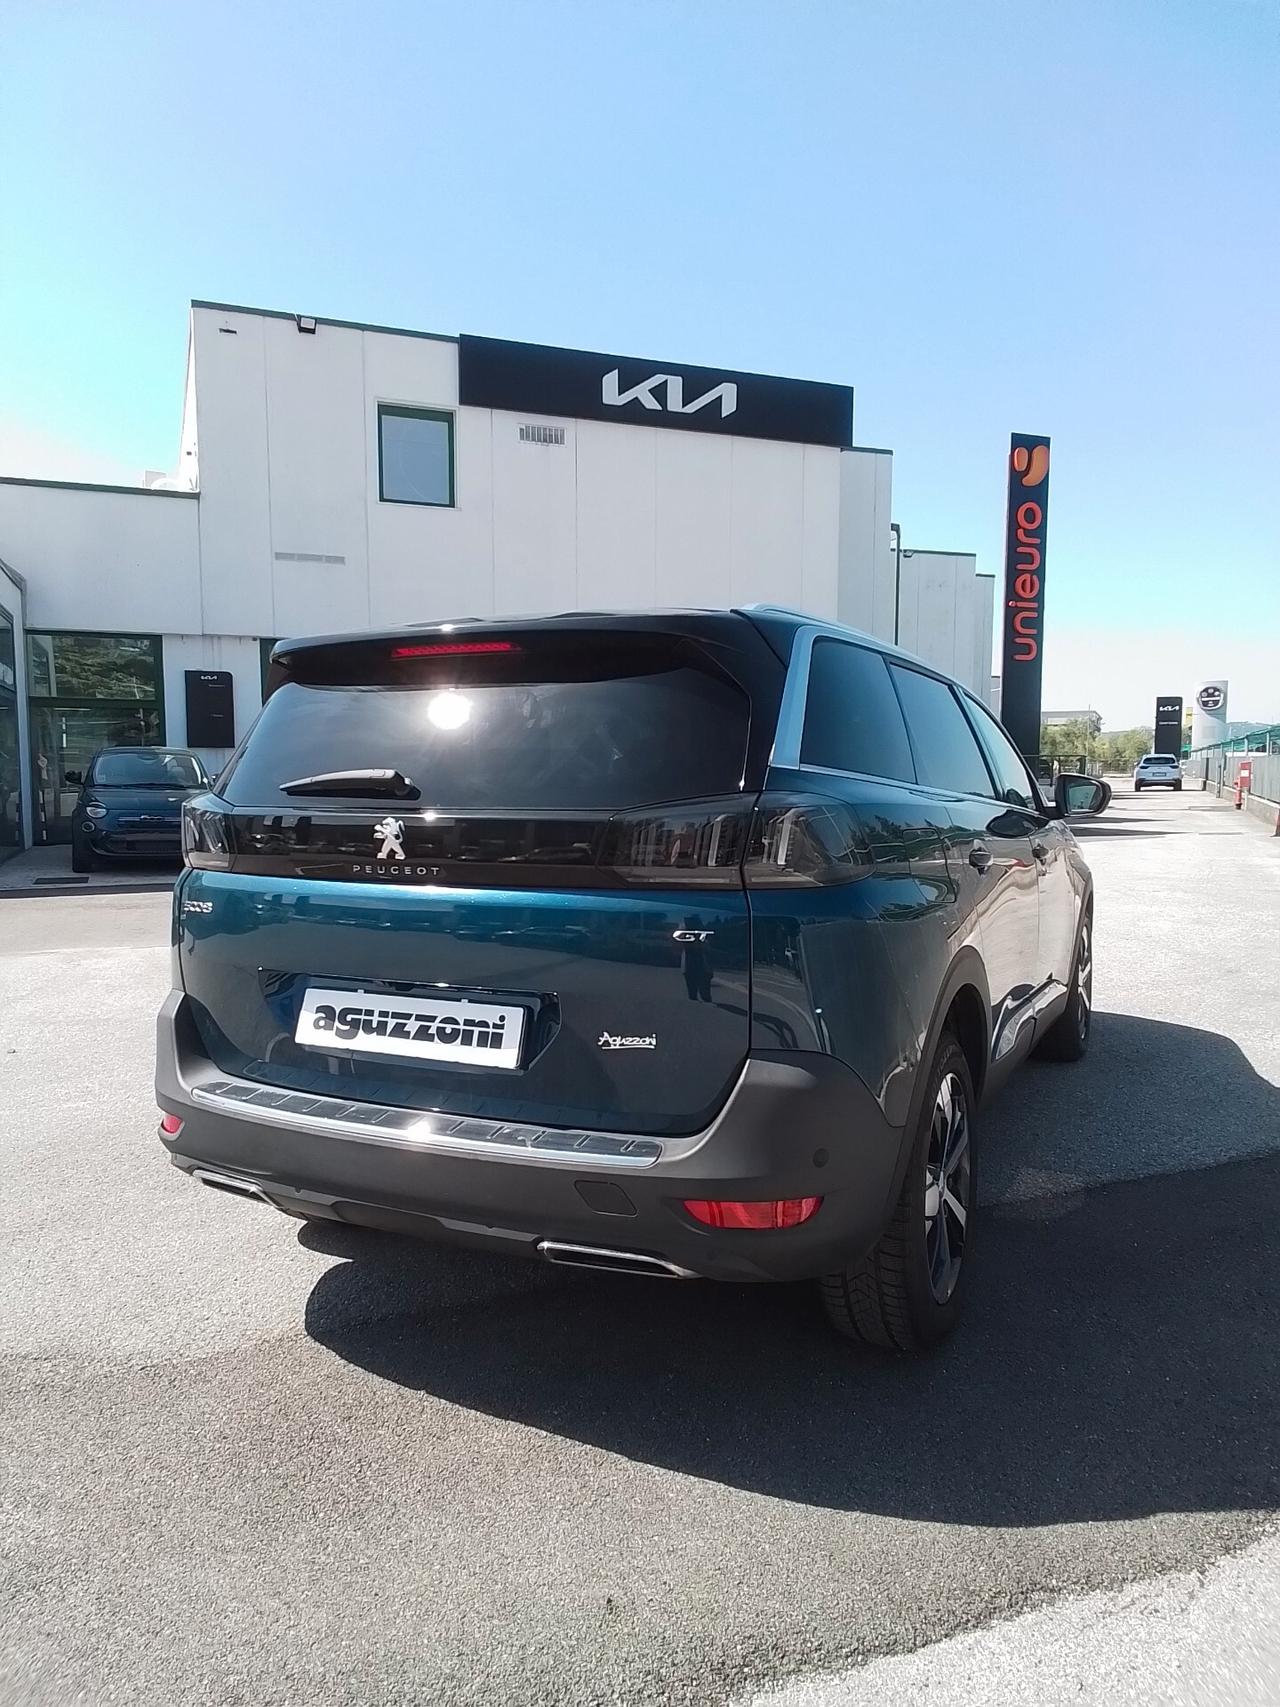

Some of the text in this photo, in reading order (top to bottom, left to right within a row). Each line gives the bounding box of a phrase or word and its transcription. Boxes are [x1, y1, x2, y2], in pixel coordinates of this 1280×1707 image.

[602, 368, 737, 418] KIA
[1008, 502, 1042, 661] unieuro
[352, 864, 440, 876] PEUGEOT
[672, 930, 715, 942] GT
[312, 1004, 506, 1050] aguzzoni
